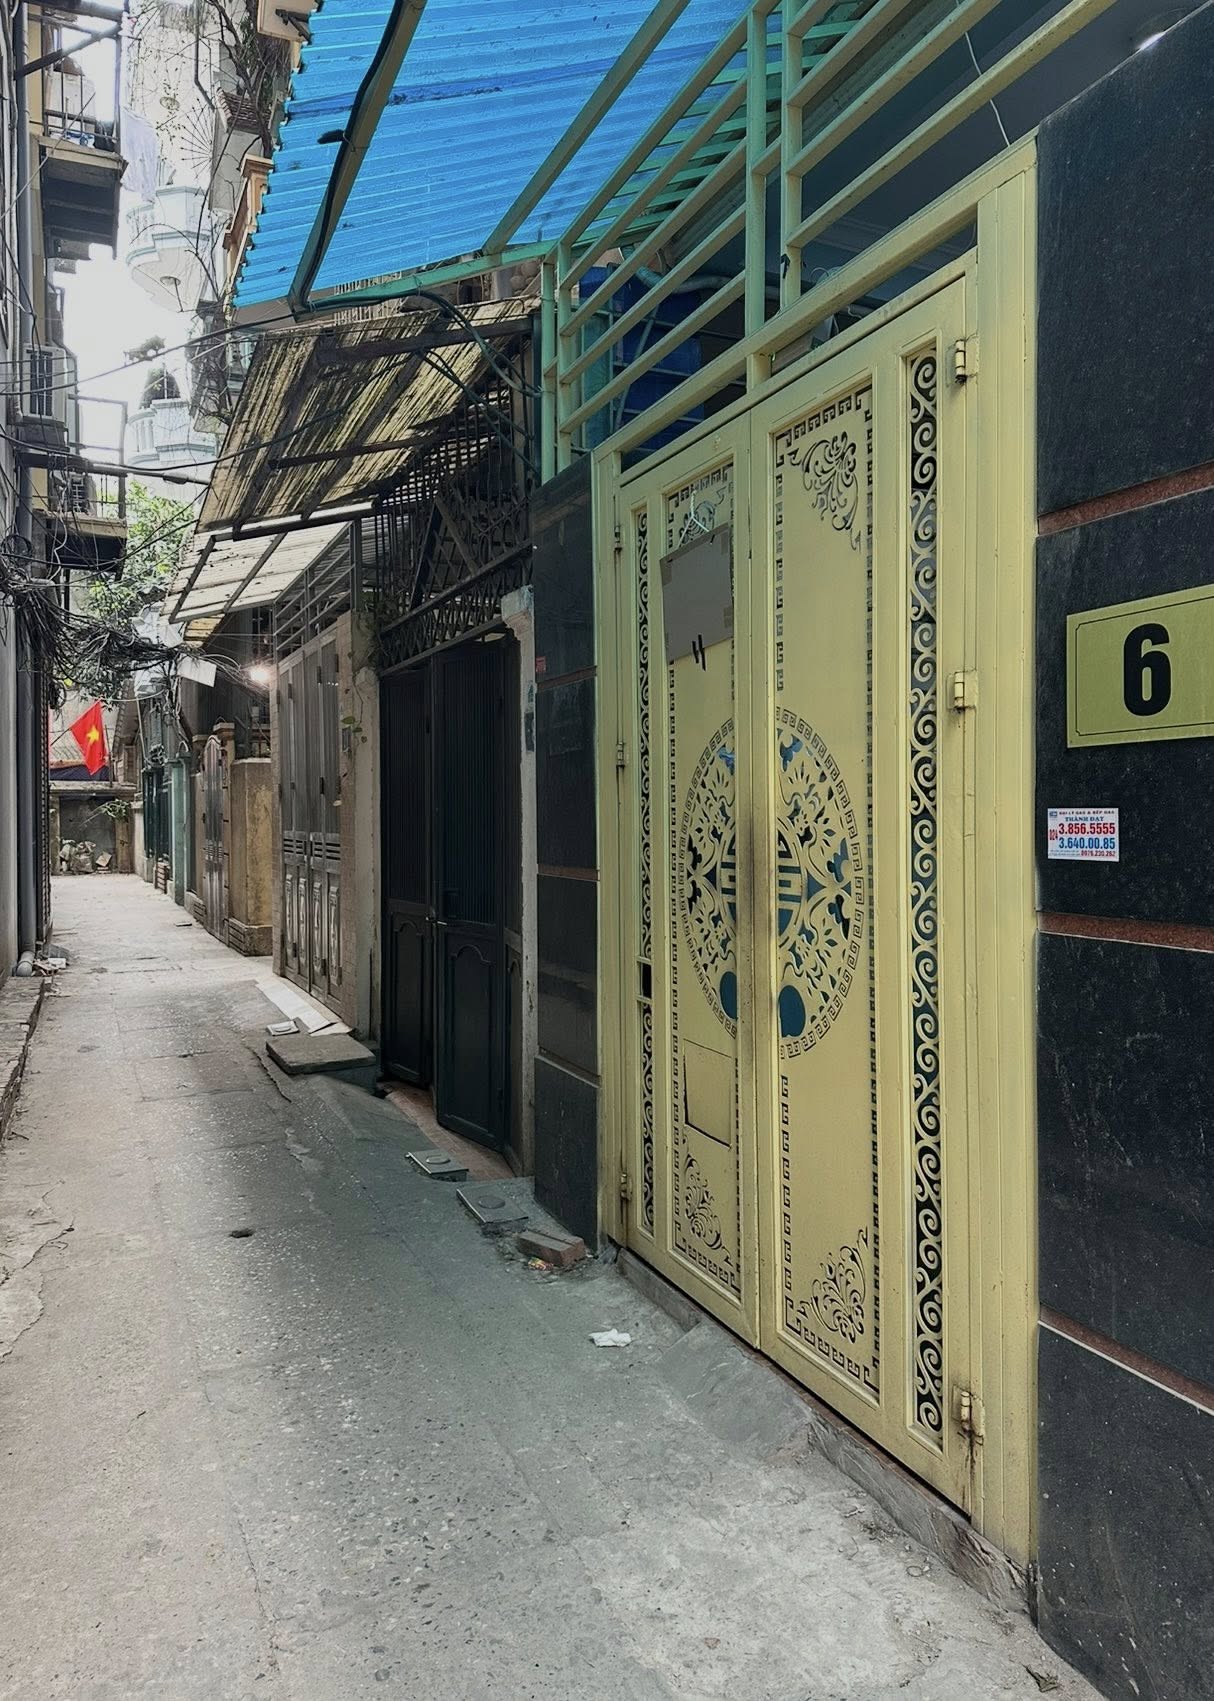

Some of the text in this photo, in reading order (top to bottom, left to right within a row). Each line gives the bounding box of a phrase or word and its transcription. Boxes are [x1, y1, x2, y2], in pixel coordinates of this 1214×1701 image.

[1124, 623, 1171, 716] 6
[1058, 823, 1116, 834] 3.856.5555
[1058, 837, 1116, 849] 3.640.00.85
